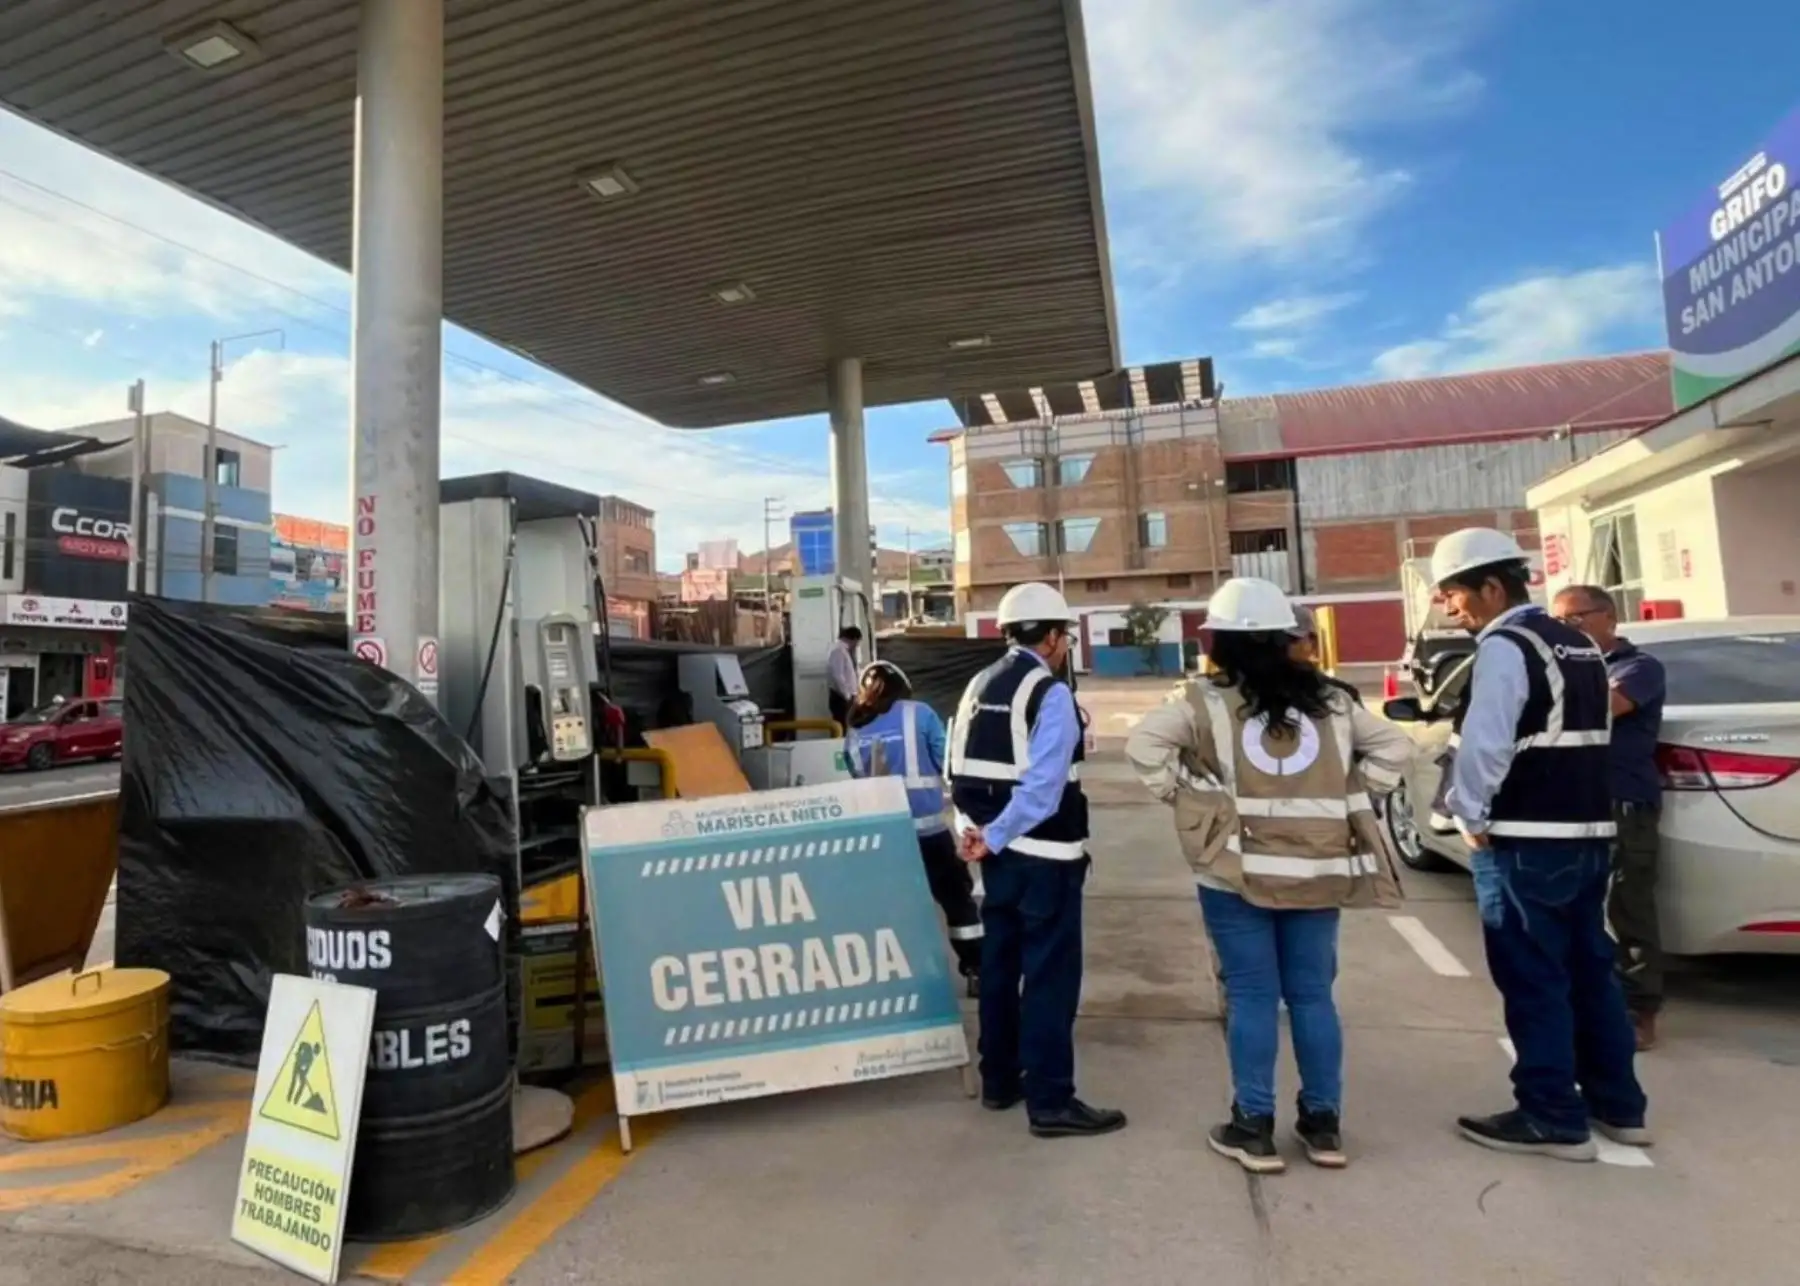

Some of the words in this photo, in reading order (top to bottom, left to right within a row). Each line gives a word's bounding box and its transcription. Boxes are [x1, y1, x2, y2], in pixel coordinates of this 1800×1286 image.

[1710, 163, 1786, 241] GRIFO
[1681, 286, 1725, 335] SAN
[1731, 233, 1800, 305] ANTO
[357, 495, 377, 537] NO
[357, 549, 378, 634] FUME
[697, 811, 788, 834] MARISCAL
[792, 804, 842, 822] NIETO
[721, 872, 817, 931] VIA
[650, 928, 912, 1012] CERRADA
[247, 1157, 337, 1206] PRECAUCIÓN
[254, 1180, 321, 1223] HOMBRES
[240, 1197, 331, 1252] TRABAJANDO
